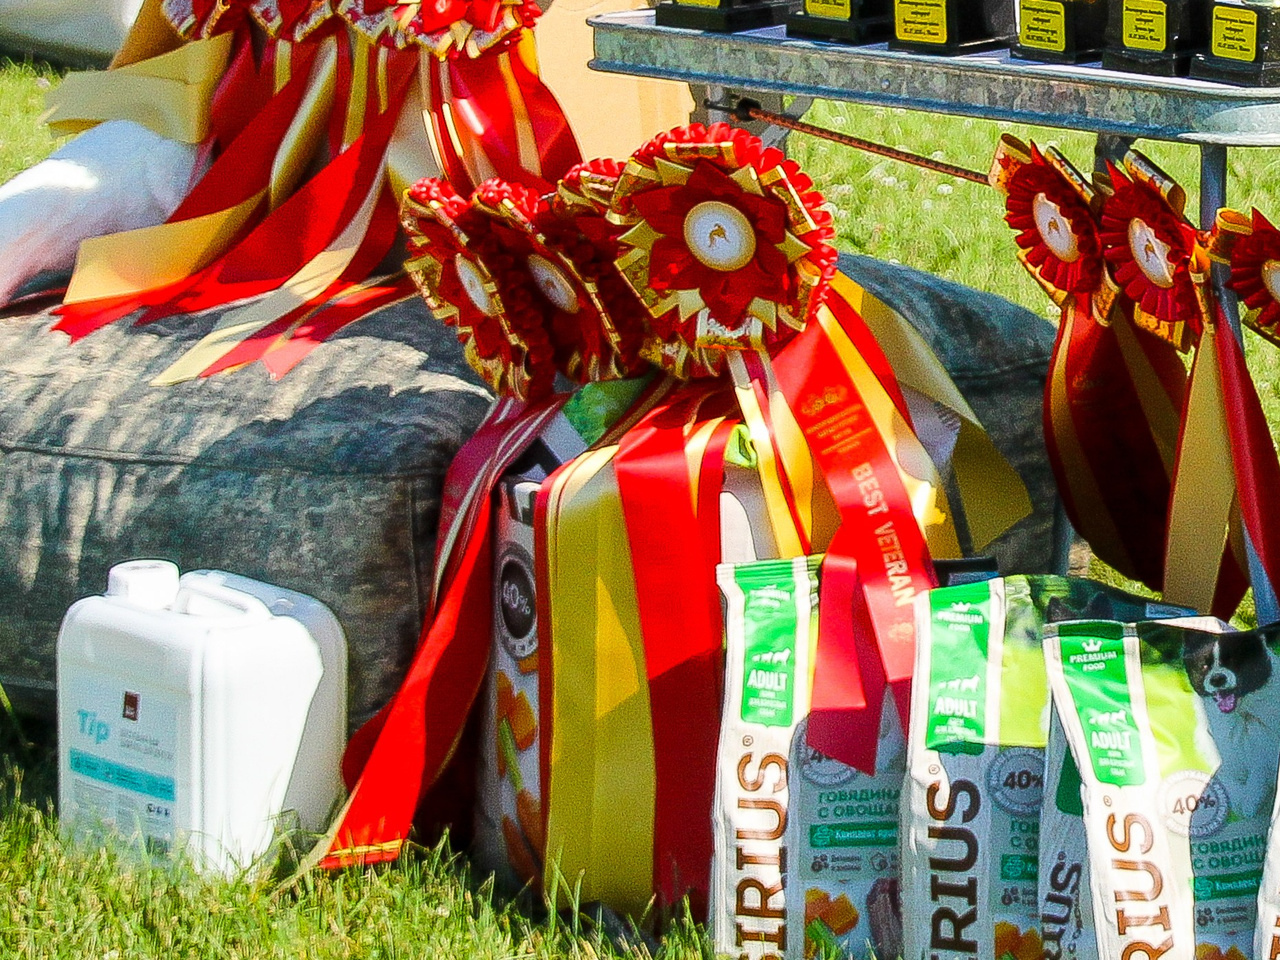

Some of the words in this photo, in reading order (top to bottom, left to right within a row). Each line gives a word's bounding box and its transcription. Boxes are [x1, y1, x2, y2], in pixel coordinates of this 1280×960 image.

[851, 461, 890, 517] BEST
[873, 520, 918, 608] VETERAN
[1069, 650, 1118, 664] PREMIUM
[746, 668, 788, 692] ADULT
[933, 695, 978, 718] ADULT
[77, 708, 111, 745] Tip
[1091, 730, 1132, 751] ADULT
[1172, 793, 1216, 816] 40%
[736, 750, 789, 960] IRIUS
[926, 778, 982, 960] RIUS
[1106, 812, 1174, 960] RIUS
